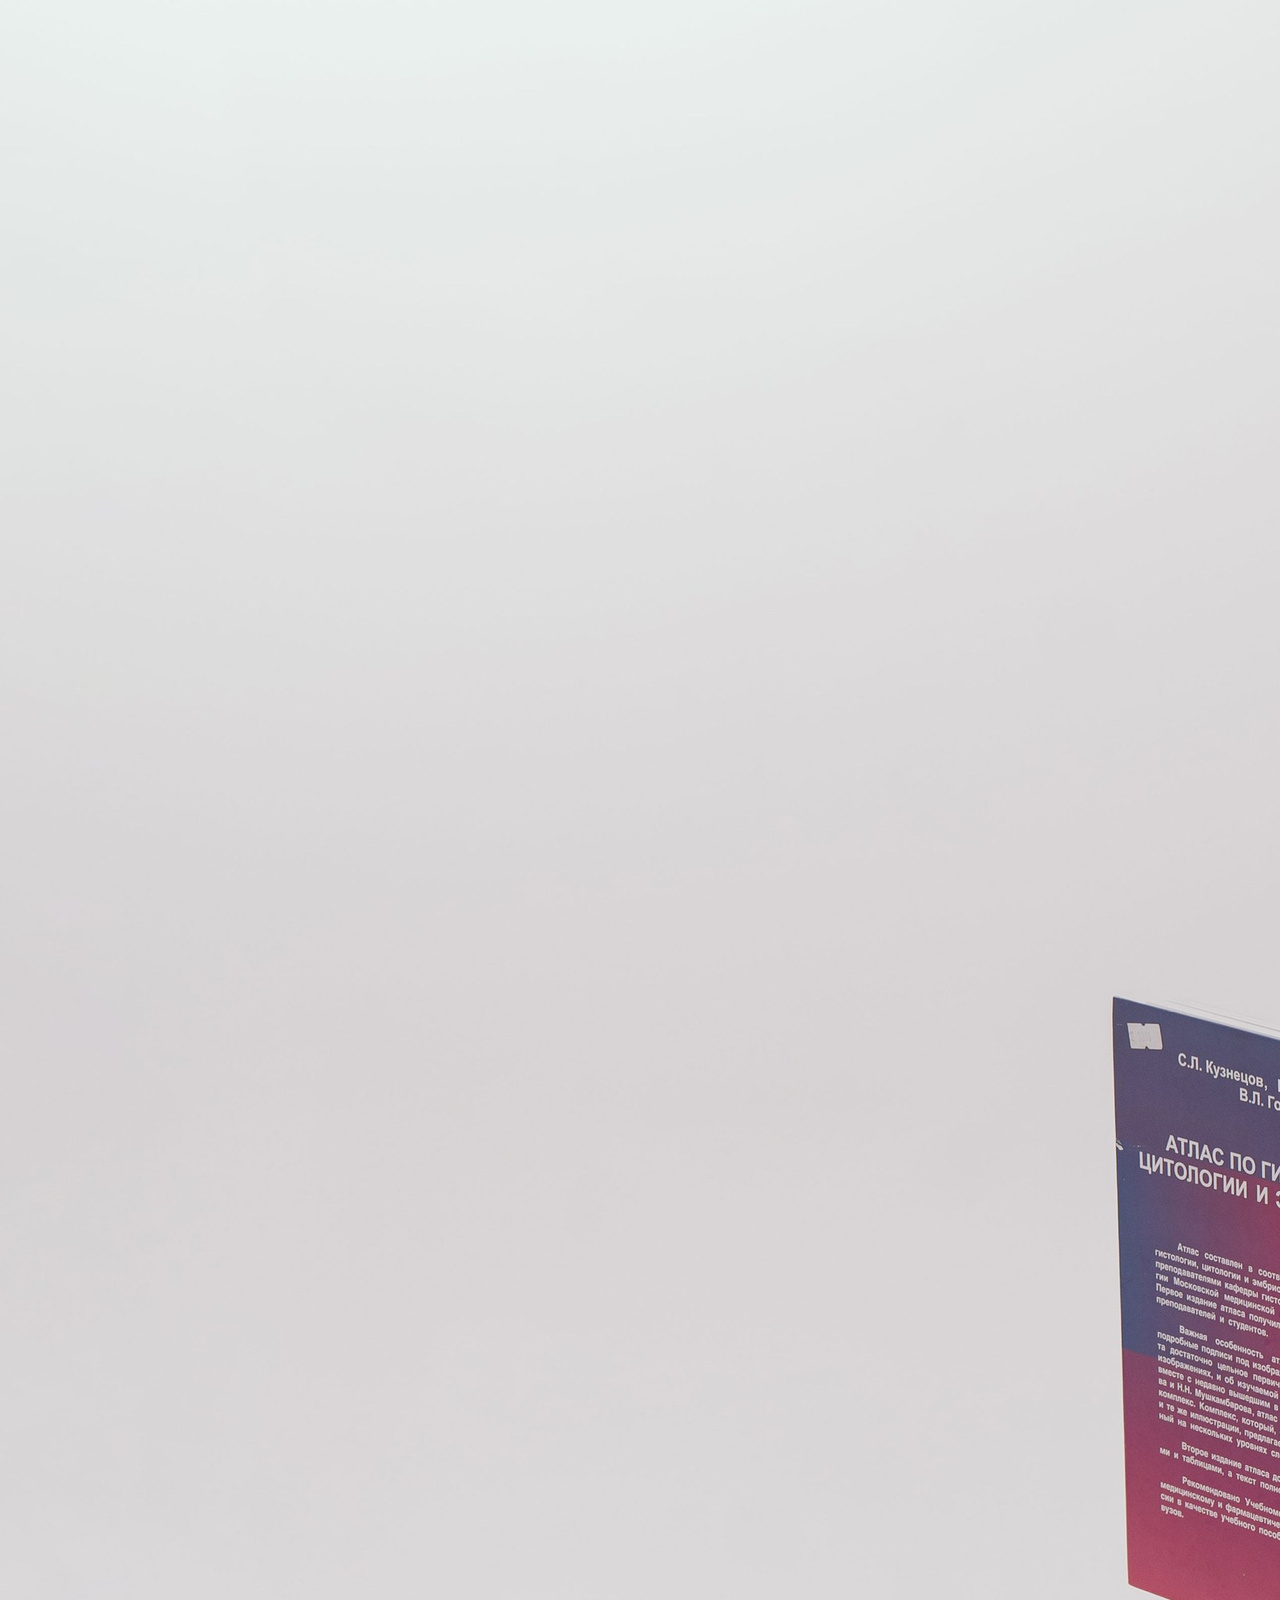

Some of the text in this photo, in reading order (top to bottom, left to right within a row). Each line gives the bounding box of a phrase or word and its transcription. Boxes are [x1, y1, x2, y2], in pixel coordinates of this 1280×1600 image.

[1178, 1053, 1202, 1071] С.Л.
[1206, 1060, 1268, 1091] Кузнецов,
[1239, 1088, 1264, 1107] В.Л.
[1165, 1135, 1225, 1166] АТЛАС
[1230, 1152, 1256, 1175] ПО
[1139, 1151, 1247, 1199] ЦИТОЛОГИИ
[1256, 1185, 1268, 1205] И
[1155, 1249, 1199, 1270] гистологии,
[1201, 1263, 1241, 1281] цитологии
[1244, 1276, 1249, 1284] и
[1177, 1243, 1199, 1257] Атлас
[1204, 1252, 1243, 1270] составлен
[1248, 1265, 1253, 1273] в
[1155, 1261, 1222, 1287] преподавателями
[1224, 1282, 1259, 1298] кафедры
[1155, 1273, 1169, 1282] гии
[1173, 1276, 1219, 1298] Московской
[1224, 1294, 1275, 1315] медицинской
[1156, 1283, 1183, 1299] Первое
[1186, 1294, 1217, 1309] издание
[1220, 1304, 1246, 1318] атласа
[1156, 1296, 1216, 1321] преподавателей
[1228, 1319, 1268, 1337] студентов.
[1157, 1331, 1199, 1350] подробные
[1201, 1345, 1233, 1361] подписи
[1235, 1356, 1250, 1368] под
[1157, 1343, 1166, 1352] та
[1170, 1347, 1213, 1366] достаточно
[1217, 1362, 1248, 1378] цельное
[1179, 1325, 1208, 1342] Важная
[1215, 1338, 1264, 1359] особенность
[1157, 1355, 1214, 1380] изображениях,
[1216, 1373, 1222, 1381] и
[1224, 1376, 1235, 1385] об
[1237, 1380, 1279, 1400] изучаемой
[1159, 1447, 1170, 1456] ми
[1182, 1455, 1224, 1476] таблицами,
[1236, 1473, 1257, 1485] текст
[1181, 1441, 1209, 1458] Второе
[1211, 1453, 1242, 1469] издание
[1244, 1464, 1270, 1479] атласа
[1160, 1482, 1215, 1508] медицинскому
[1217, 1501, 1223, 1509] и
[1182, 1476, 1240, 1503] Рекомендовано
[1160, 1493, 1174, 1503] сии
[1185, 1501, 1218, 1519] качестве
[1221, 1512, 1256, 1532] учебного
[1161, 1504, 1184, 1518] вузов.
